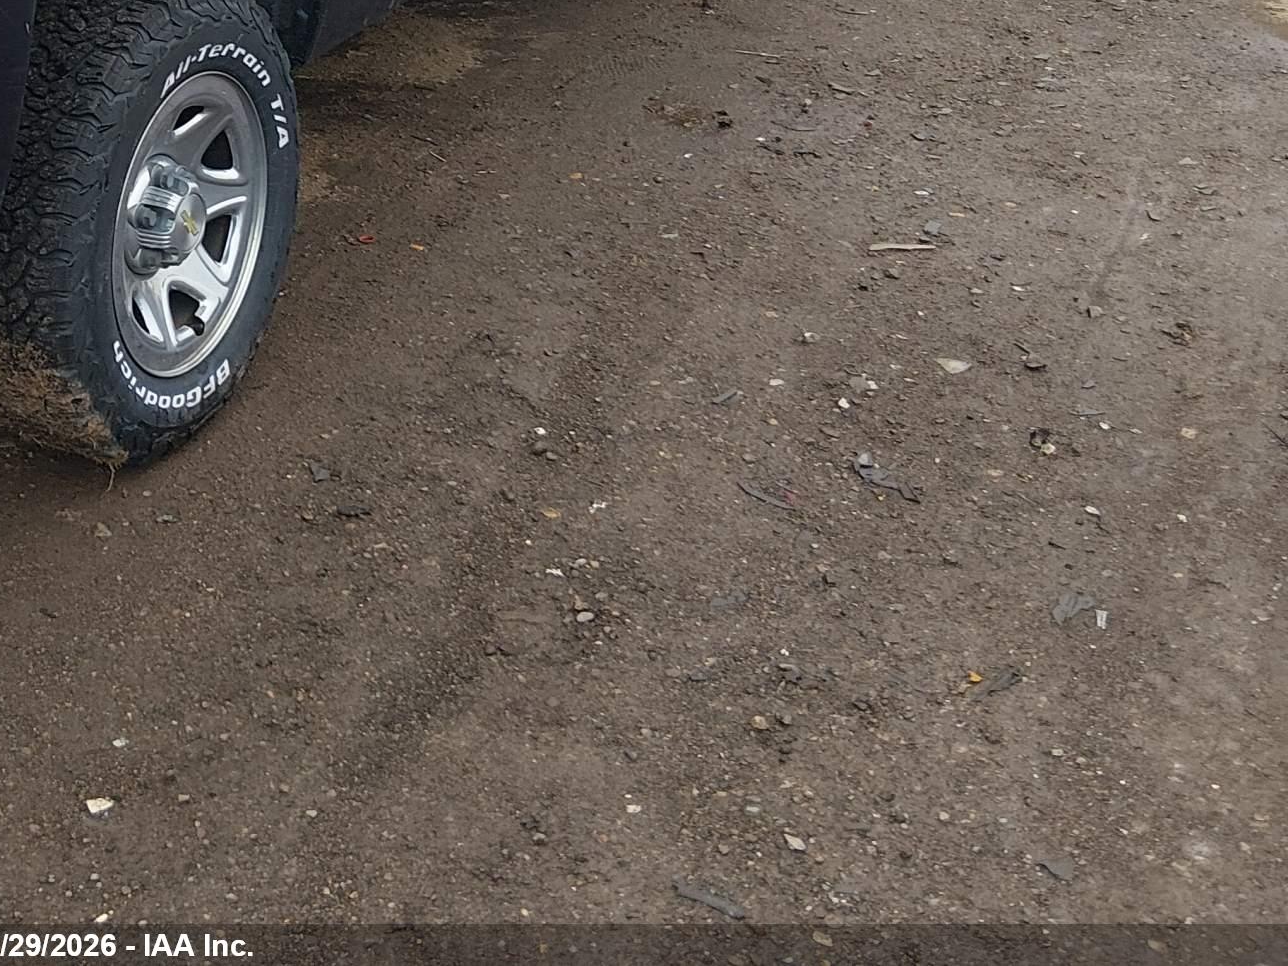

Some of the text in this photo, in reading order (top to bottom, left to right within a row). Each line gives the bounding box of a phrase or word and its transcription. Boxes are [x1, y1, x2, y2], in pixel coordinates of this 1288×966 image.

[160, 42, 290, 149] All-Terrain T/A
[113, 340, 231, 409] BFGoodrich
